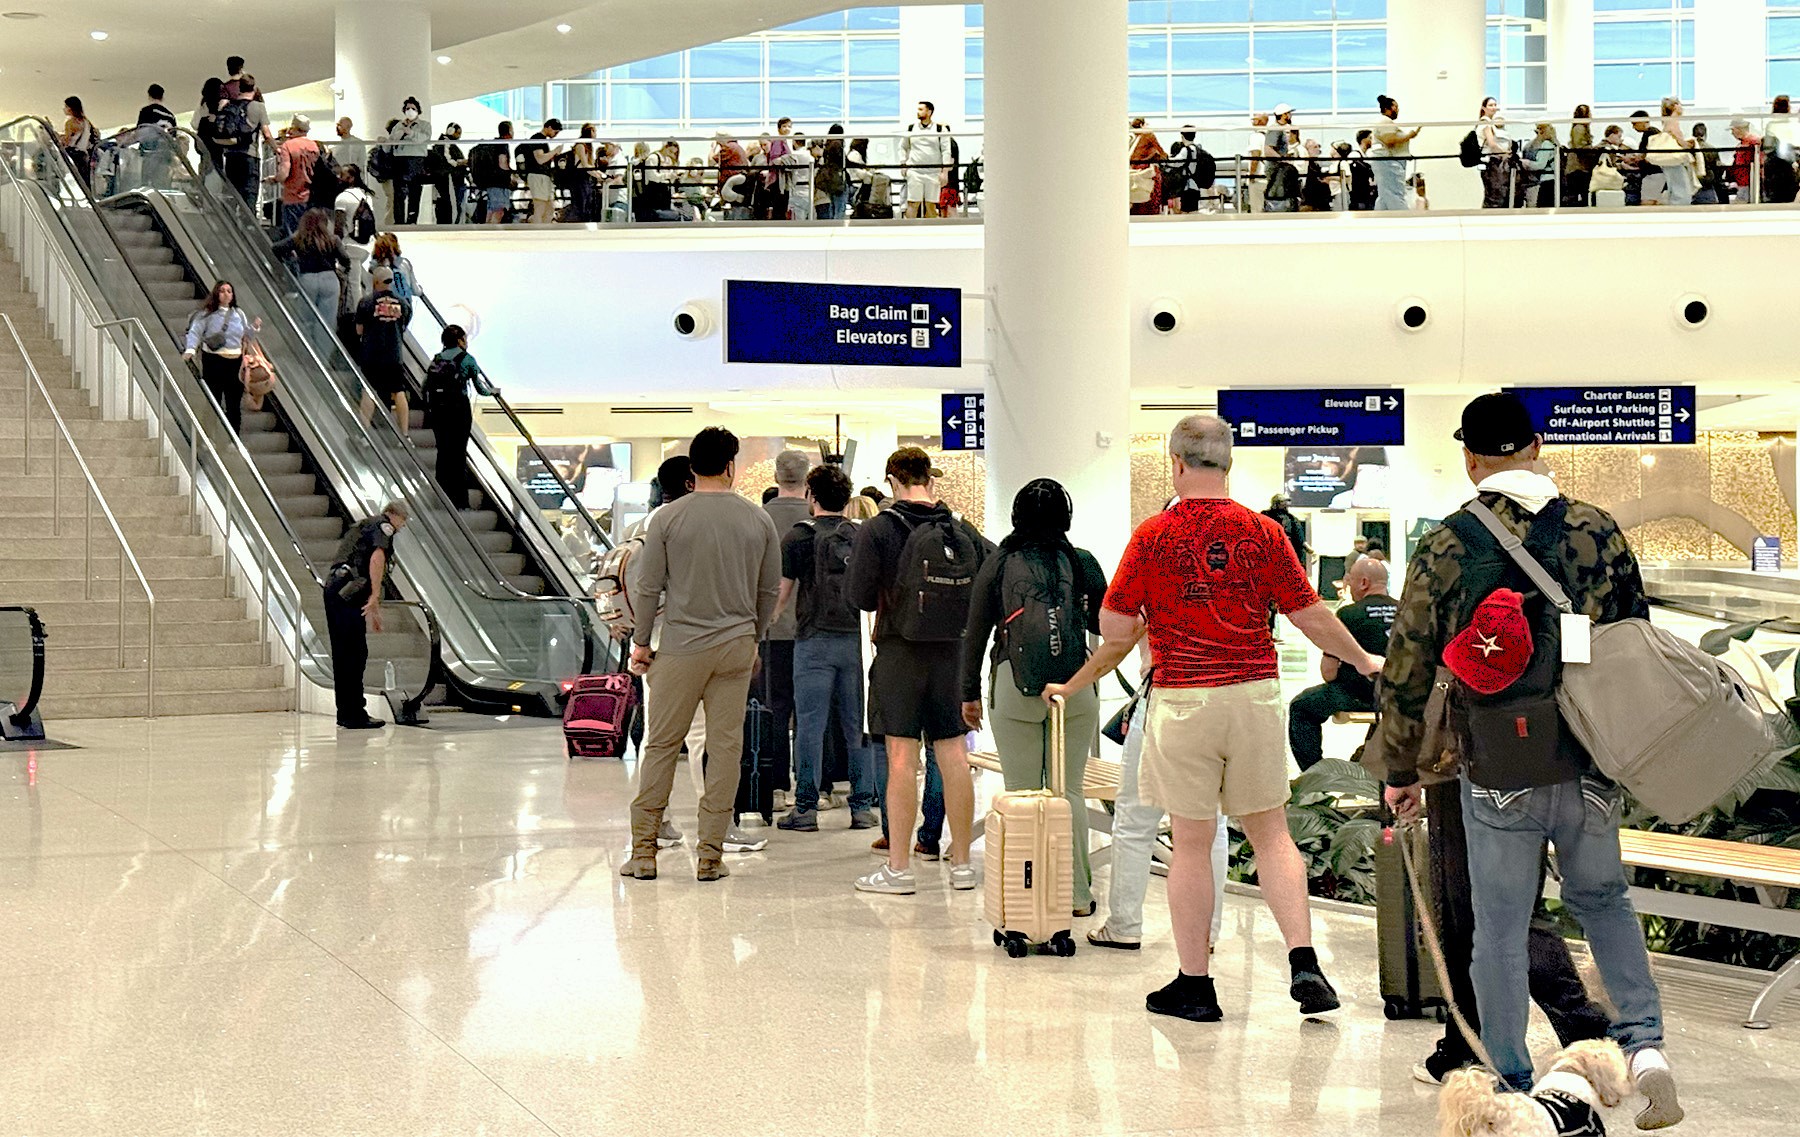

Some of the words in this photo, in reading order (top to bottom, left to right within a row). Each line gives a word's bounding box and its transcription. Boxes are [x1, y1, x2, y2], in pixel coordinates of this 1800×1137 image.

[829, 304, 860, 323] Bag
[865, 304, 908, 321] Claim
[836, 328, 908, 345] Elevators
[1583, 390, 1623, 401] Charter
[1626, 390, 1656, 401] Buses
[1324, 398, 1363, 409] Elevator
[1553, 403, 1594, 415] Surface
[1596, 404, 1614, 414] Lot
[1616, 403, 1656, 416] Parking
[1548, 417, 1610, 430] Off-Airport
[1612, 417, 1656, 428] Shuttles
[1257, 426, 1306, 437] Passenger
[1307, 425, 1339, 437] Pickup
[1544, 431, 1613, 442] International
[1614, 430, 1656, 442] Arrivals
[1049, 634, 1060, 657] CITY
